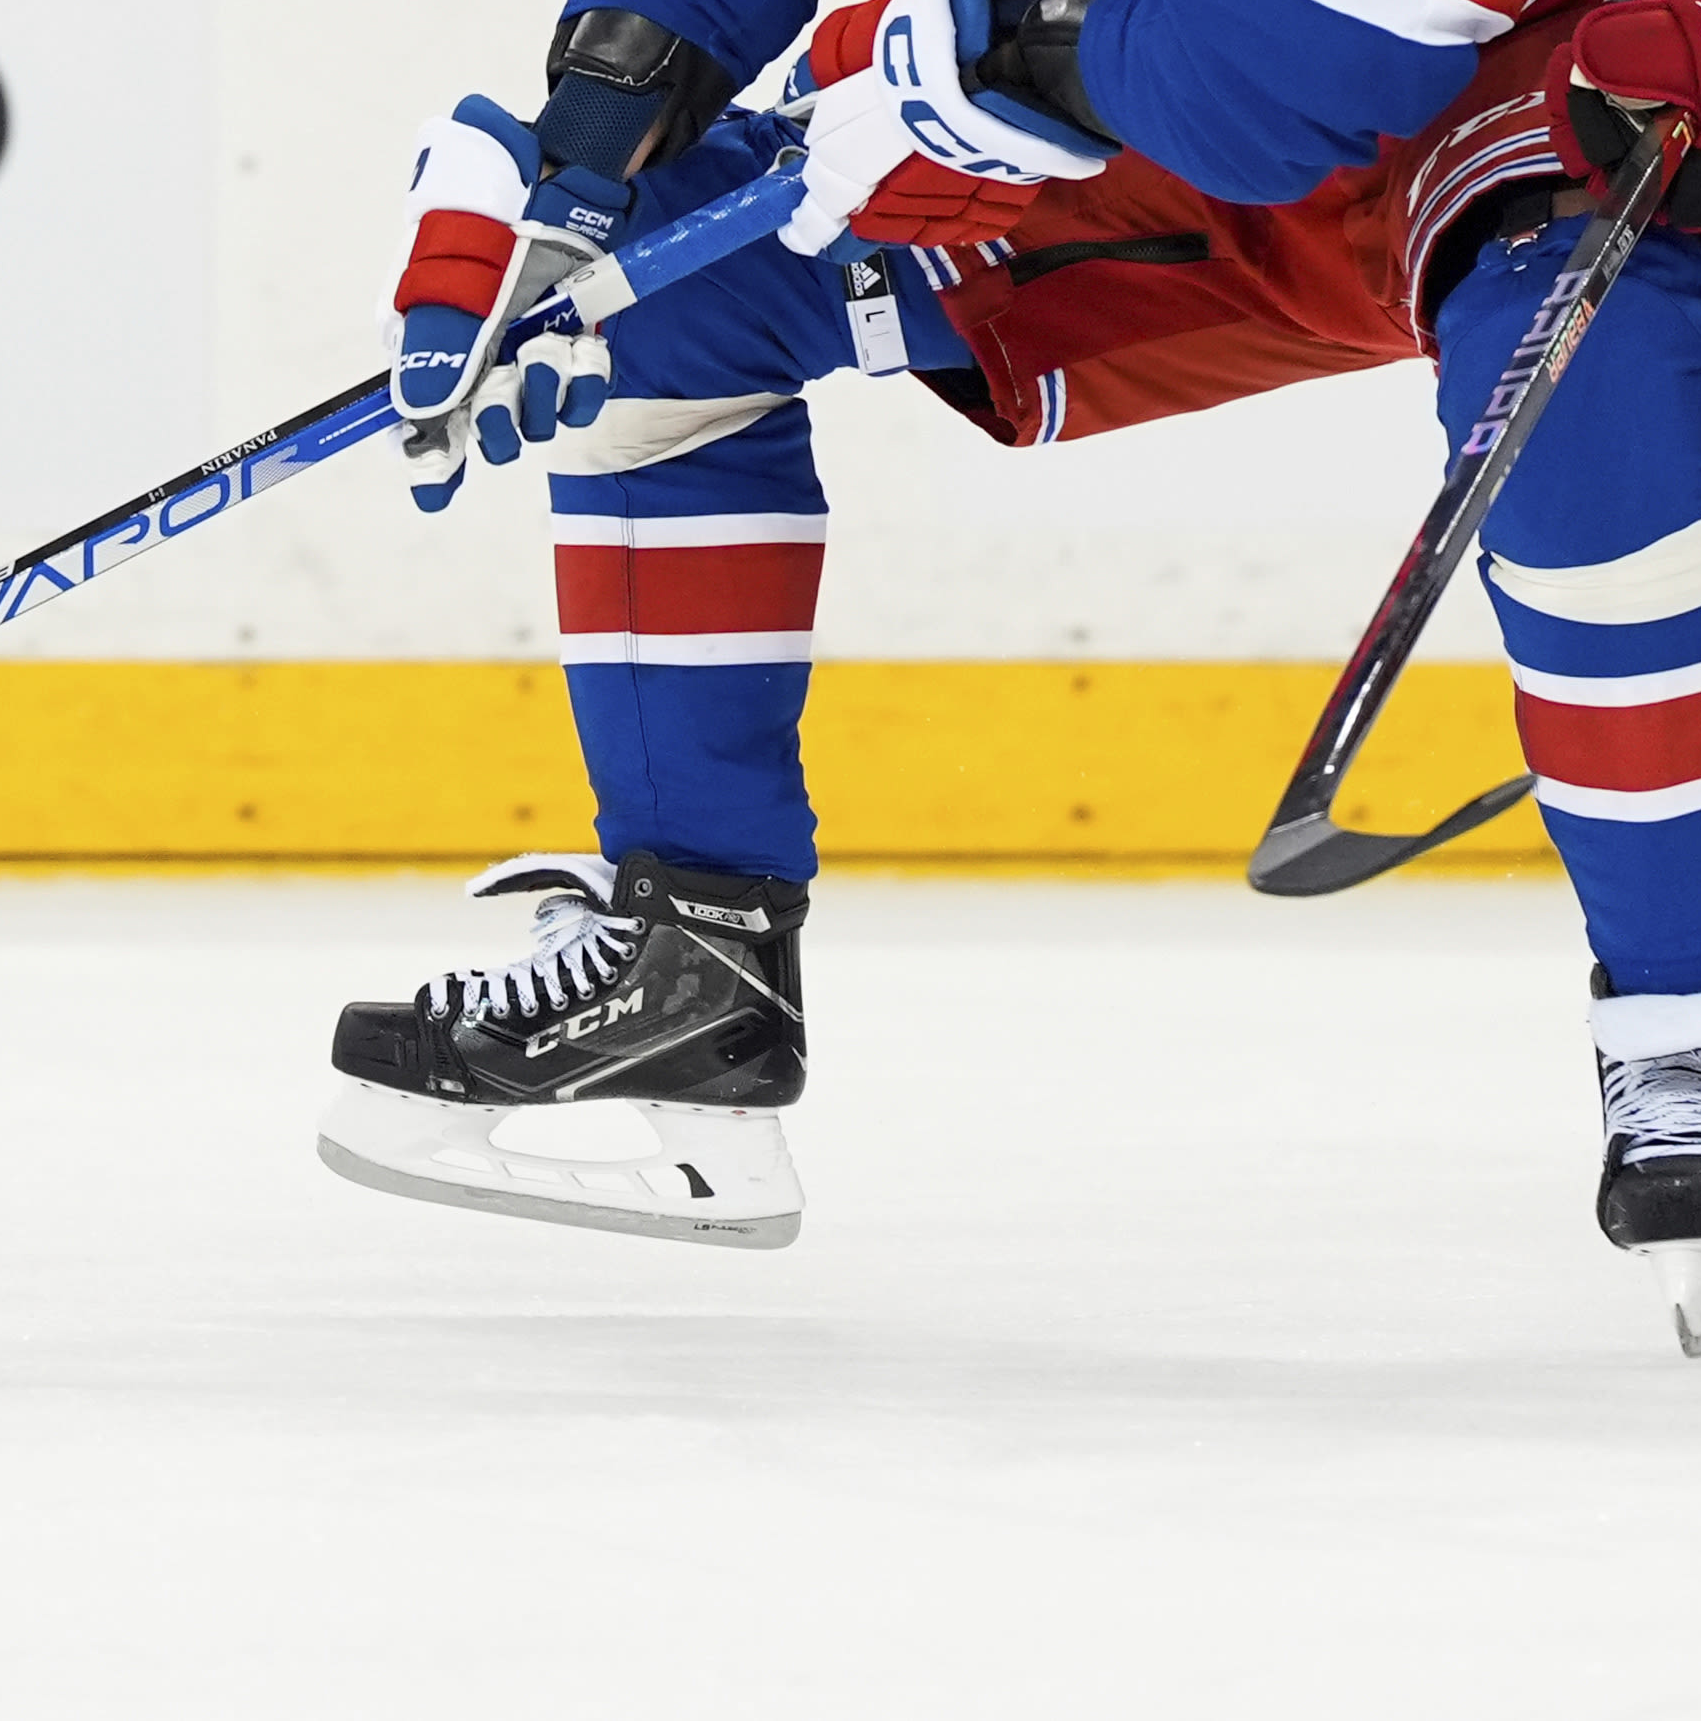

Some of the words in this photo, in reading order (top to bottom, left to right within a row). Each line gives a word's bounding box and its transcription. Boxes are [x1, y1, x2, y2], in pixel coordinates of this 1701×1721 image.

[568, 206, 614, 230] CCM
[200, 429, 279, 477] PANARIN
[525, 986, 644, 1058] CCM
